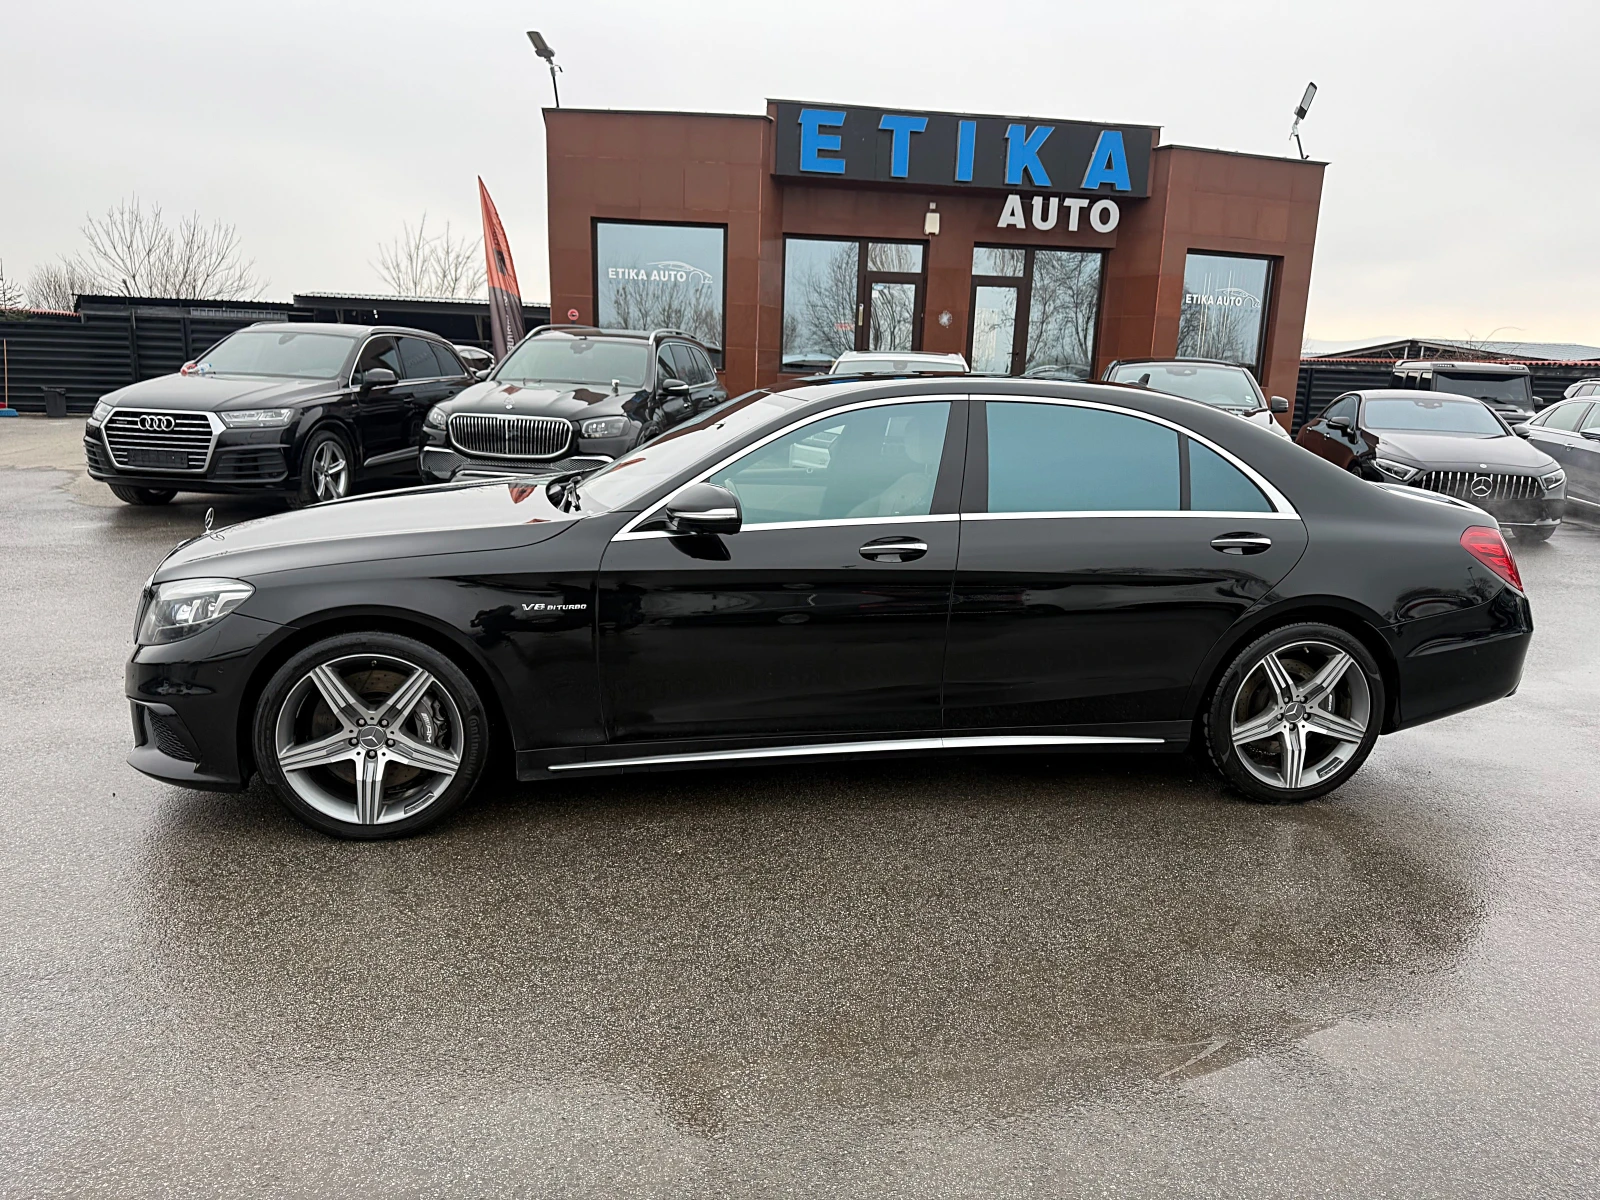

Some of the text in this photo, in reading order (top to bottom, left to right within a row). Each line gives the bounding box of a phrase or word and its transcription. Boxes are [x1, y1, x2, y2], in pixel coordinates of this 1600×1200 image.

[798, 108, 1132, 191] ETIKA
[997, 194, 1120, 233] AUTO
[608, 268, 687, 282] ETIKA AUTO
[1185, 294, 1242, 307] ETIKA AUTO
[521, 603, 545, 611] V8
[464, 715, 481, 778] Continental
